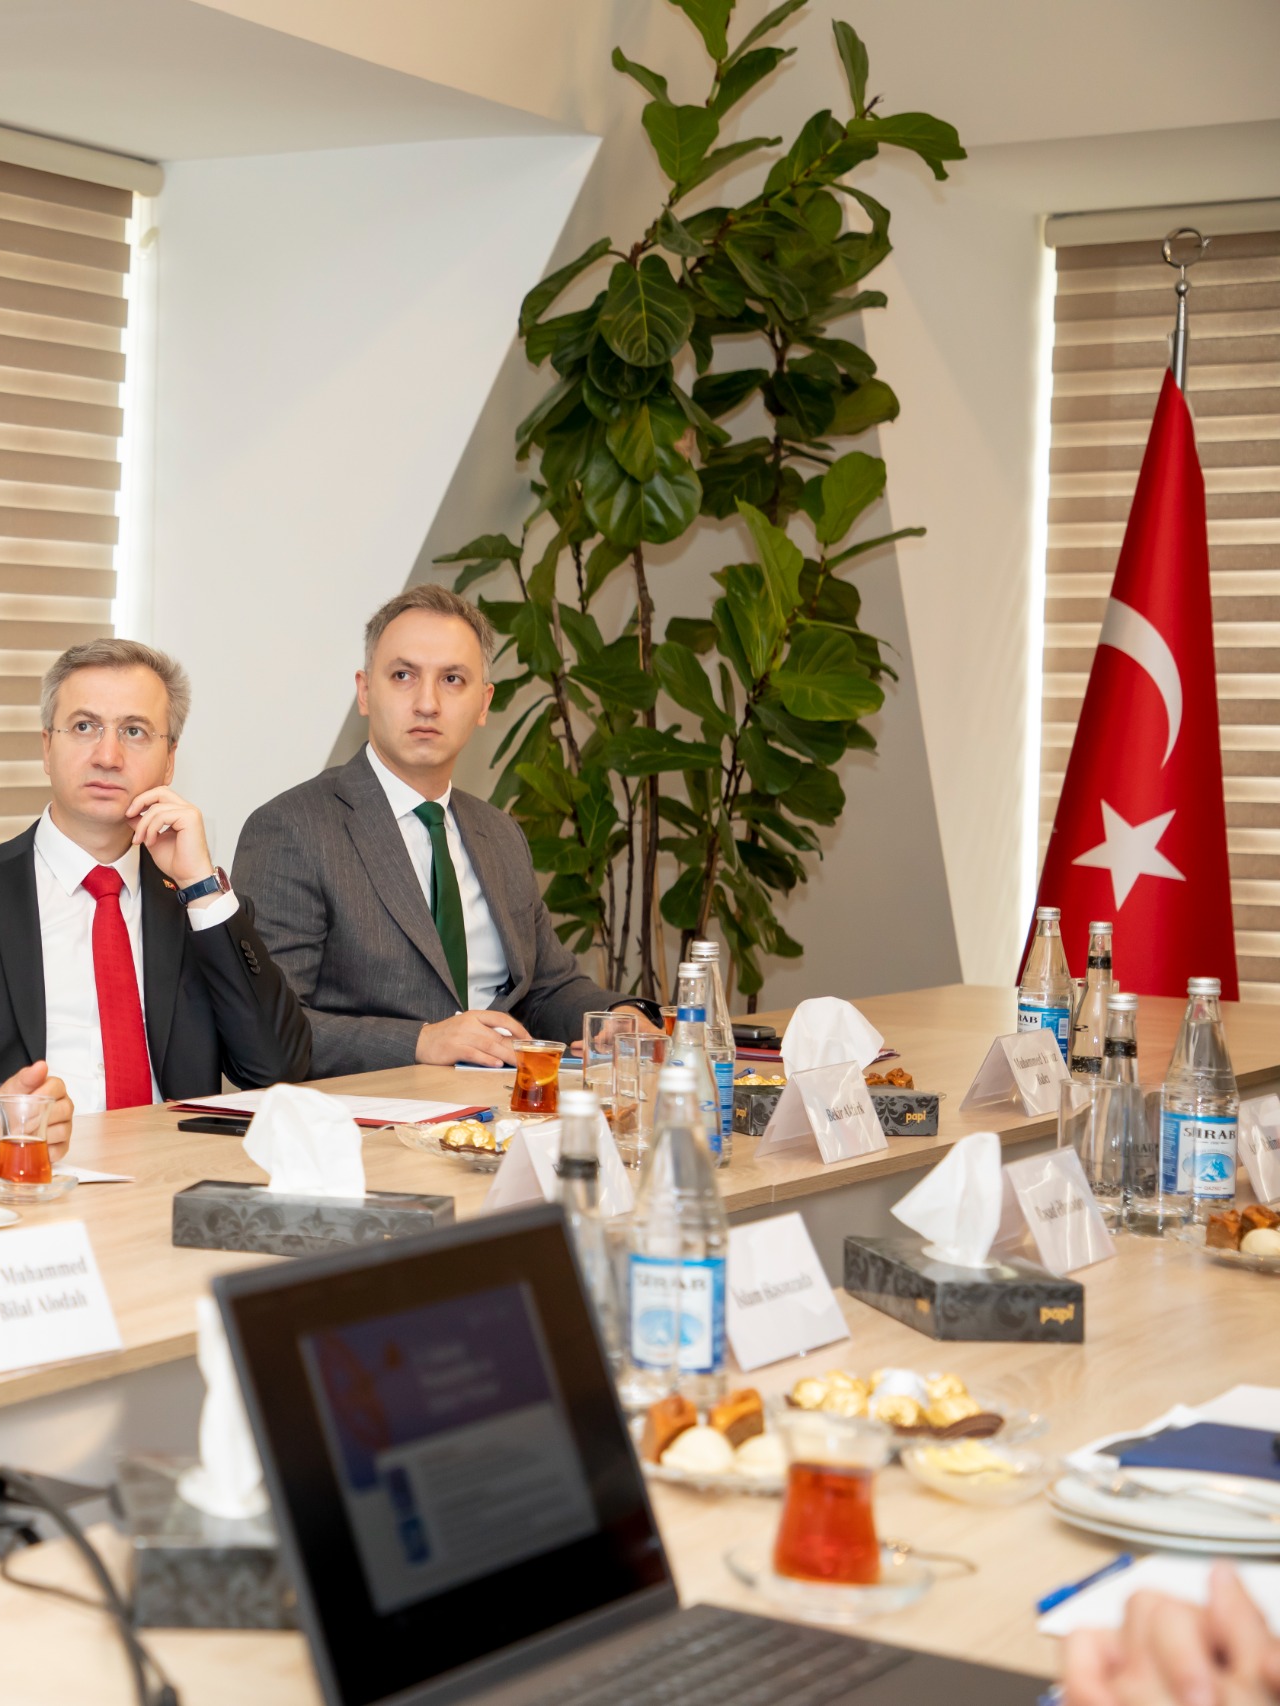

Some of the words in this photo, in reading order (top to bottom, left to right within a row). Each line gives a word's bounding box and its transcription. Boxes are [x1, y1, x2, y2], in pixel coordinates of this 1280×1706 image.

[905, 1110, 927, 1123] papi
[2, 1257, 88, 1285] Muhammed
[1040, 1304, 1075, 1325] papi
